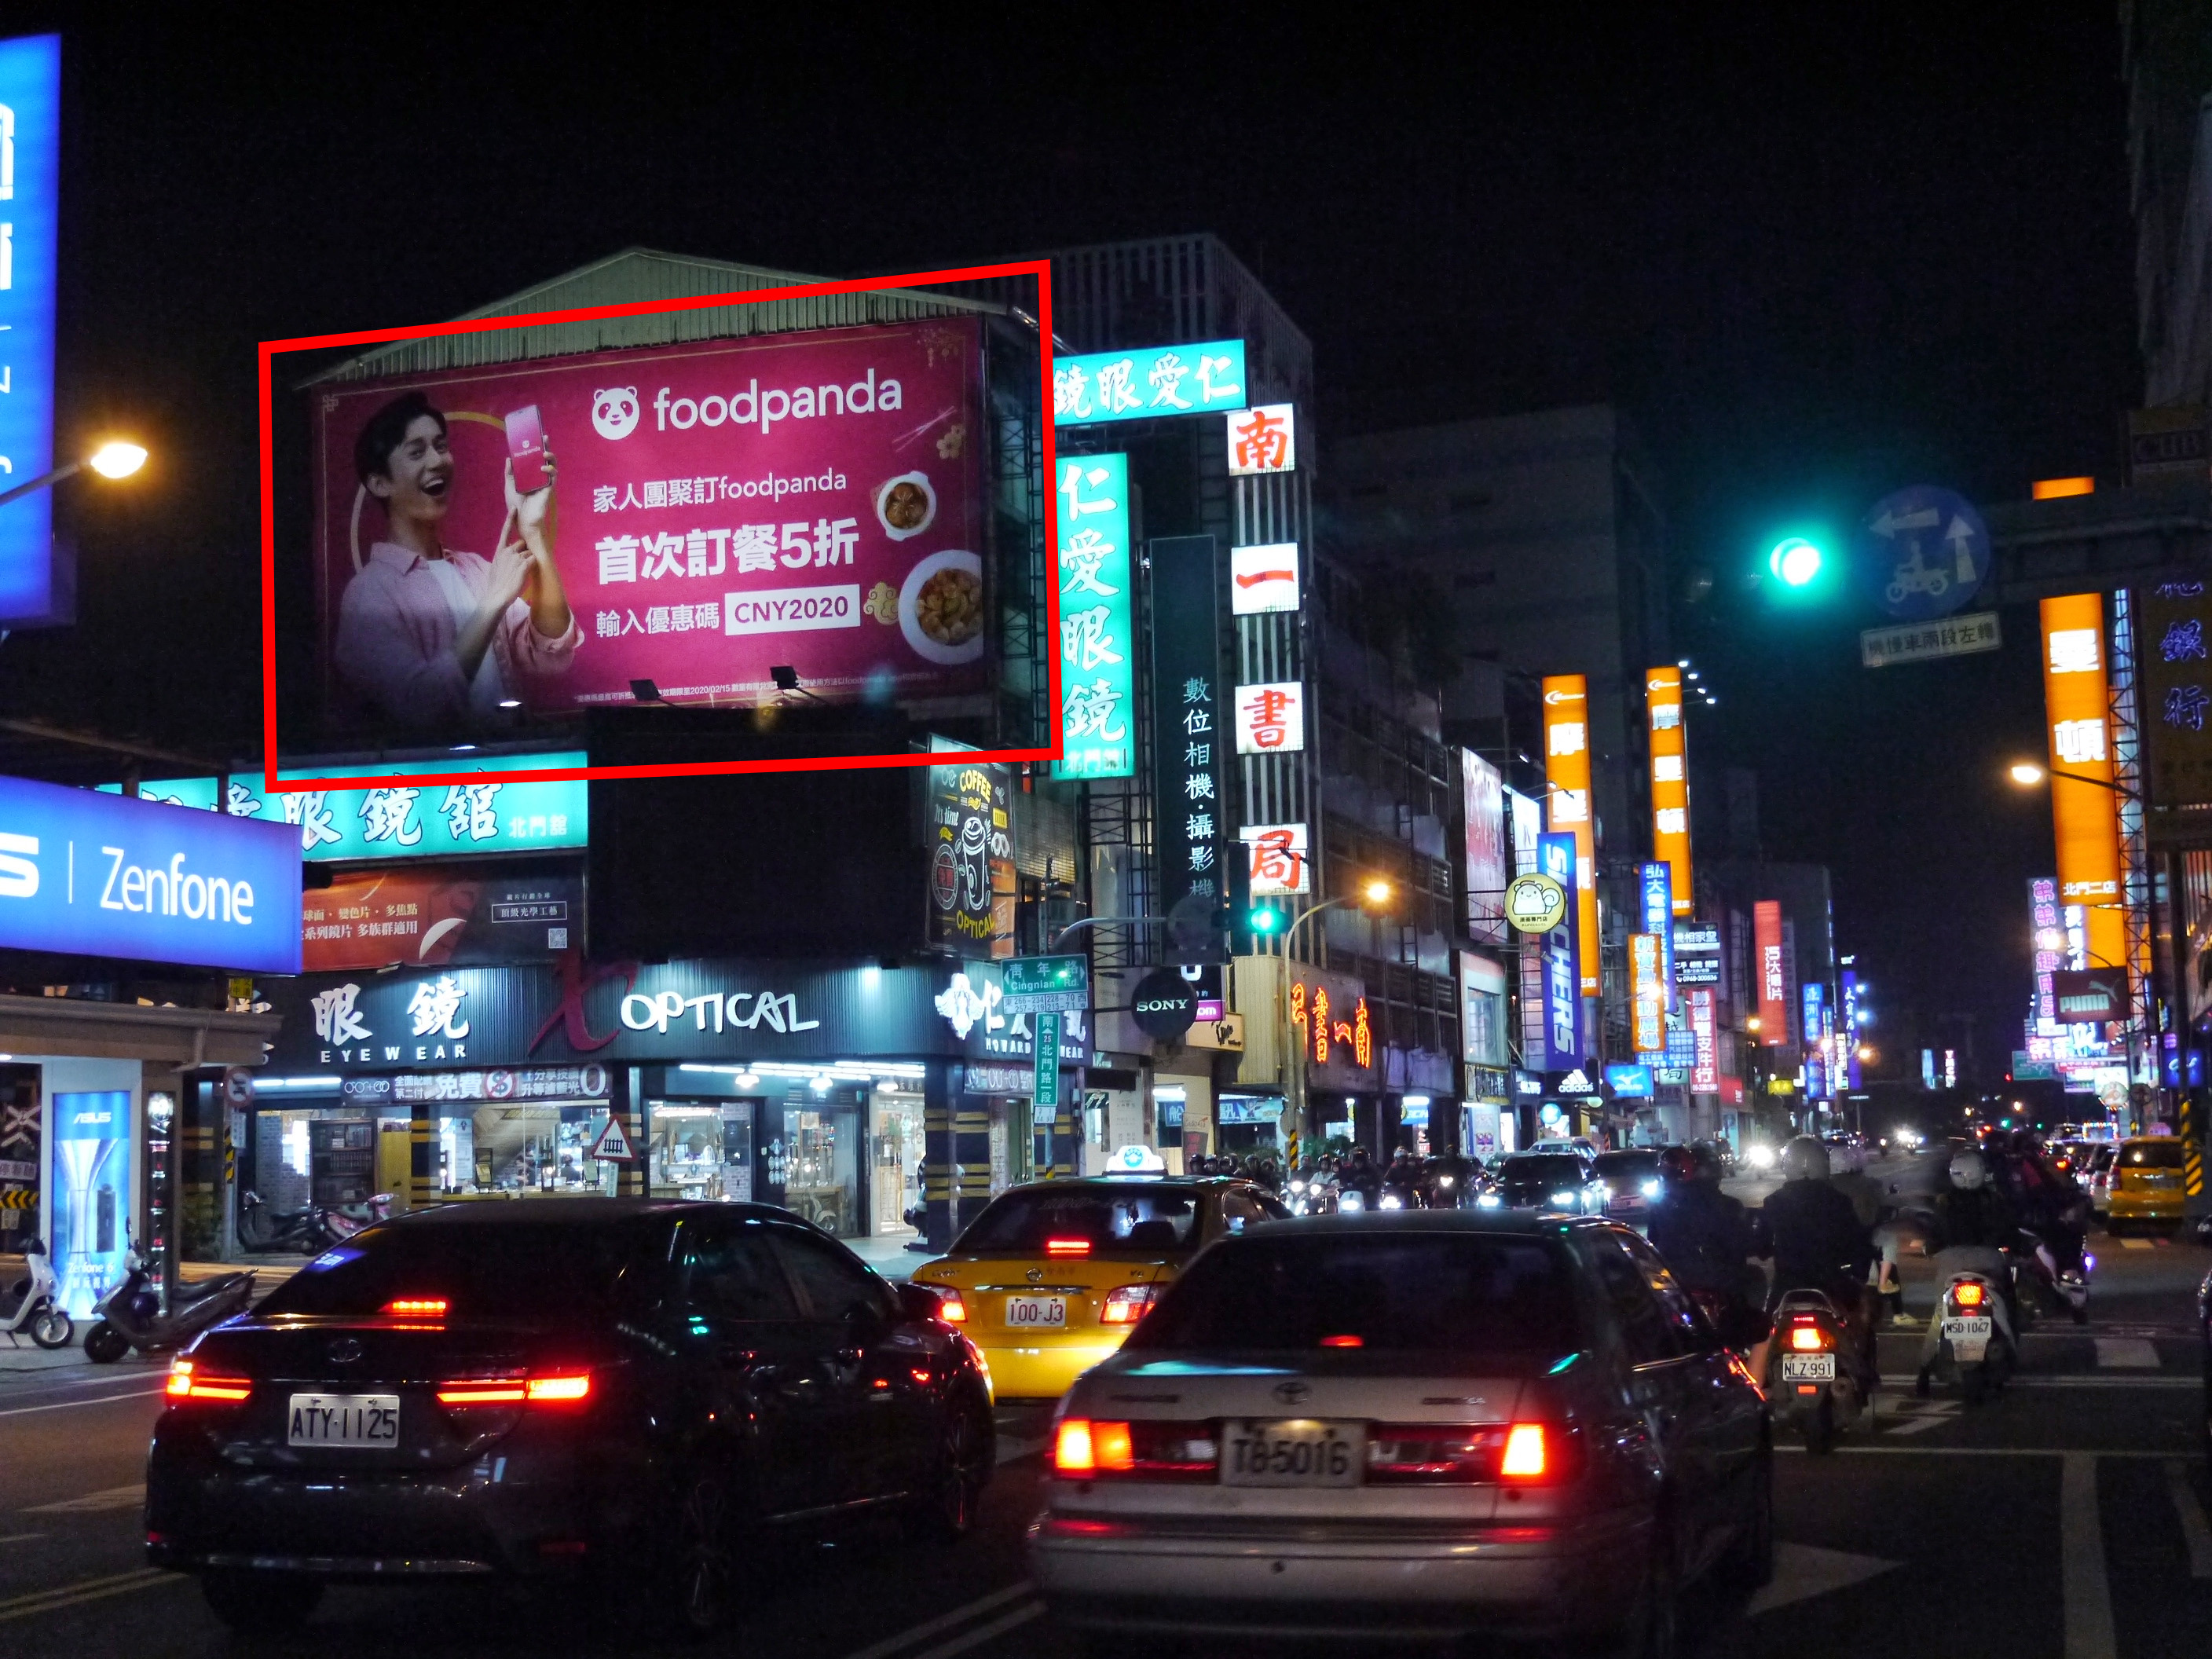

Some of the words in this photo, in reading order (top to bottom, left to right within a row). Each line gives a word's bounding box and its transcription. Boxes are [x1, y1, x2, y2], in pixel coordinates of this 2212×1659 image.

[654, 368, 903, 435] foodpanda
[595, 518, 860, 585] 首次訂餐5折
[596, 602, 720, 638] 輸入優惠碼
[734, 595, 848, 624] CNY2020
[1058, 463, 1127, 743] 仁愛眼鏡
[1235, 410, 1303, 891] 南一書局
[959, 769, 992, 804] COFFEE
[100, 846, 254, 925] Zenfone
[956, 909, 995, 939] OPTICAL
[1546, 844, 1575, 1056] SCHERS
[1011, 981, 1055, 991] Cingnian
[1064, 979, 1079, 987] Rd.
[311, 976, 470, 1046] 眼鏡
[621, 991, 819, 1034] OPTICAL
[1137, 998, 1188, 1012] SONY
[2060, 994, 2110, 1013] PUMA
[1042, 1015, 1053, 1027] 南
[986, 1037, 1031, 1054] HOWARD
[437, 1071, 483, 1101] 免費
[1040, 1045, 1053, 1104] 北門路一段
[1558, 1082, 1593, 1093] adidas
[73, 1112, 112, 1124] ASUS
[68, 1262, 104, 1273] Zenfone
[1010, 1302, 1064, 1322] 100-J3
[1946, 1321, 1990, 1334] MSD-1067
[1784, 1361, 1832, 1376] NLZ-991
[291, 1407, 397, 1439] ATY-1125
